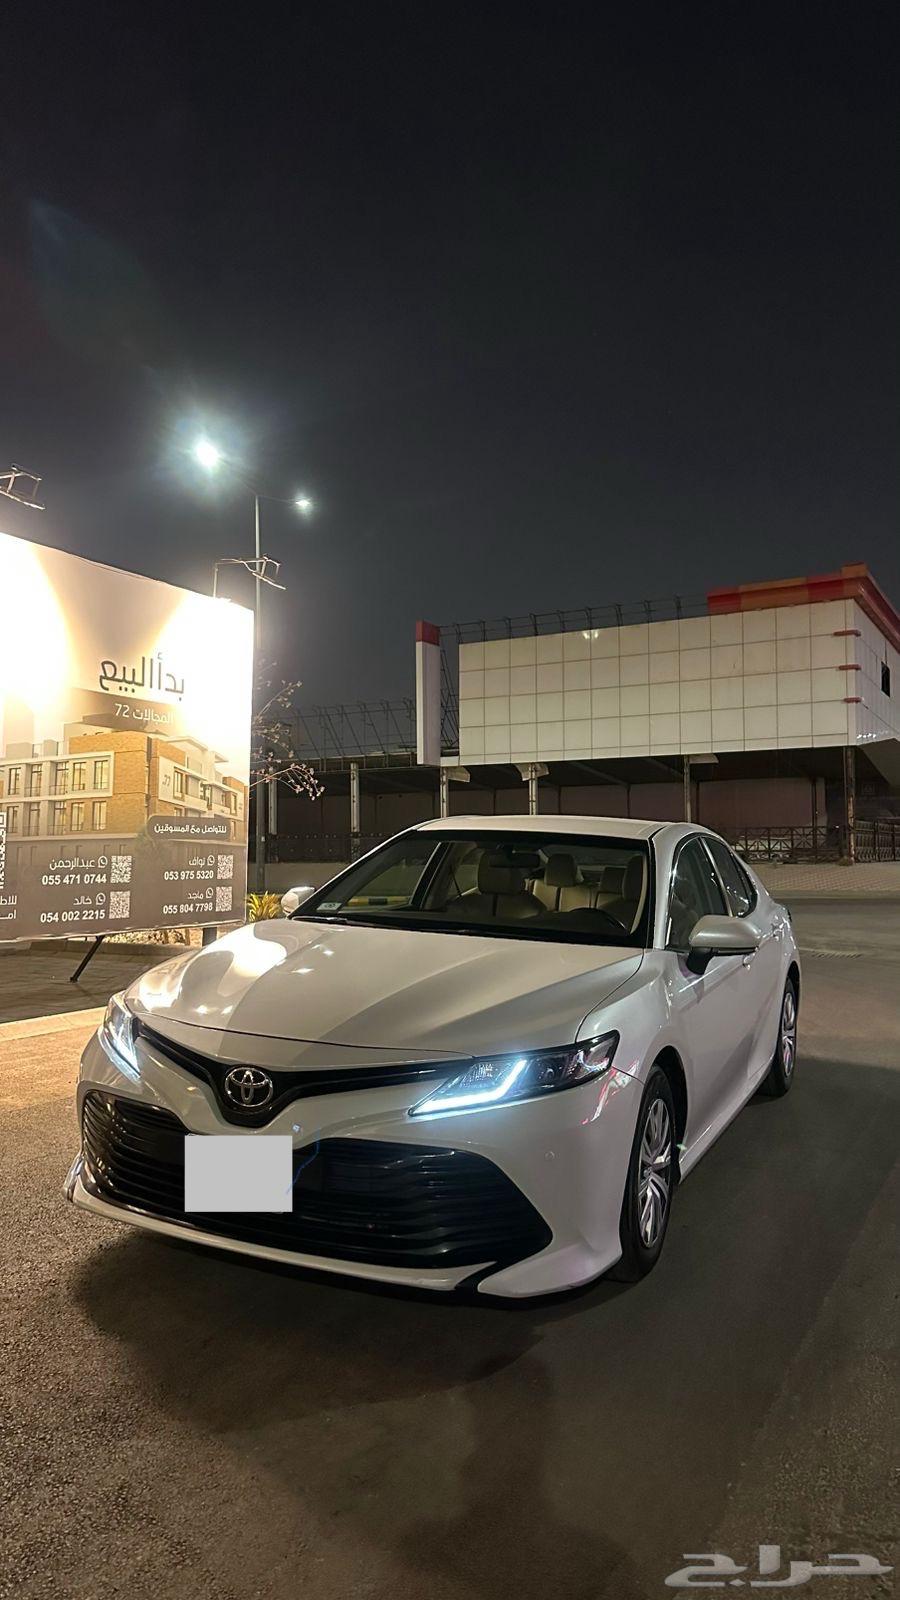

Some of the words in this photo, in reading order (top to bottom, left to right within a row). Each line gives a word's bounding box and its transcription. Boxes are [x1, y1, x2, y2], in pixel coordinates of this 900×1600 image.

[99, 656, 153, 693] البيع
[157, 652, 184, 701] بدأ
[115, 703, 130, 718] 72
[154, 823, 190, 833] المسوقين
[201, 825, 227, 835] للتواصل
[49, 857, 96, 871] عبدالرحمن
[188, 856, 206, 868] نواف
[41, 874, 61, 885] 055
[63, 874, 81, 885] 471
[83, 873, 107, 884] 0744
[164, 871, 179, 881] 053
[180, 870, 195, 880] 975
[196, 870, 214, 880] 5320
[73, 895, 92, 906] خالد
[187, 890, 204, 901] ماجد
[162, 904, 178, 915] 055
[179, 903, 194, 914] 804
[195, 902, 213, 912] 7798
[40, 912, 59, 923] 054
[61, 911, 80, 922] 002
[81, 909, 106, 921] 2215
